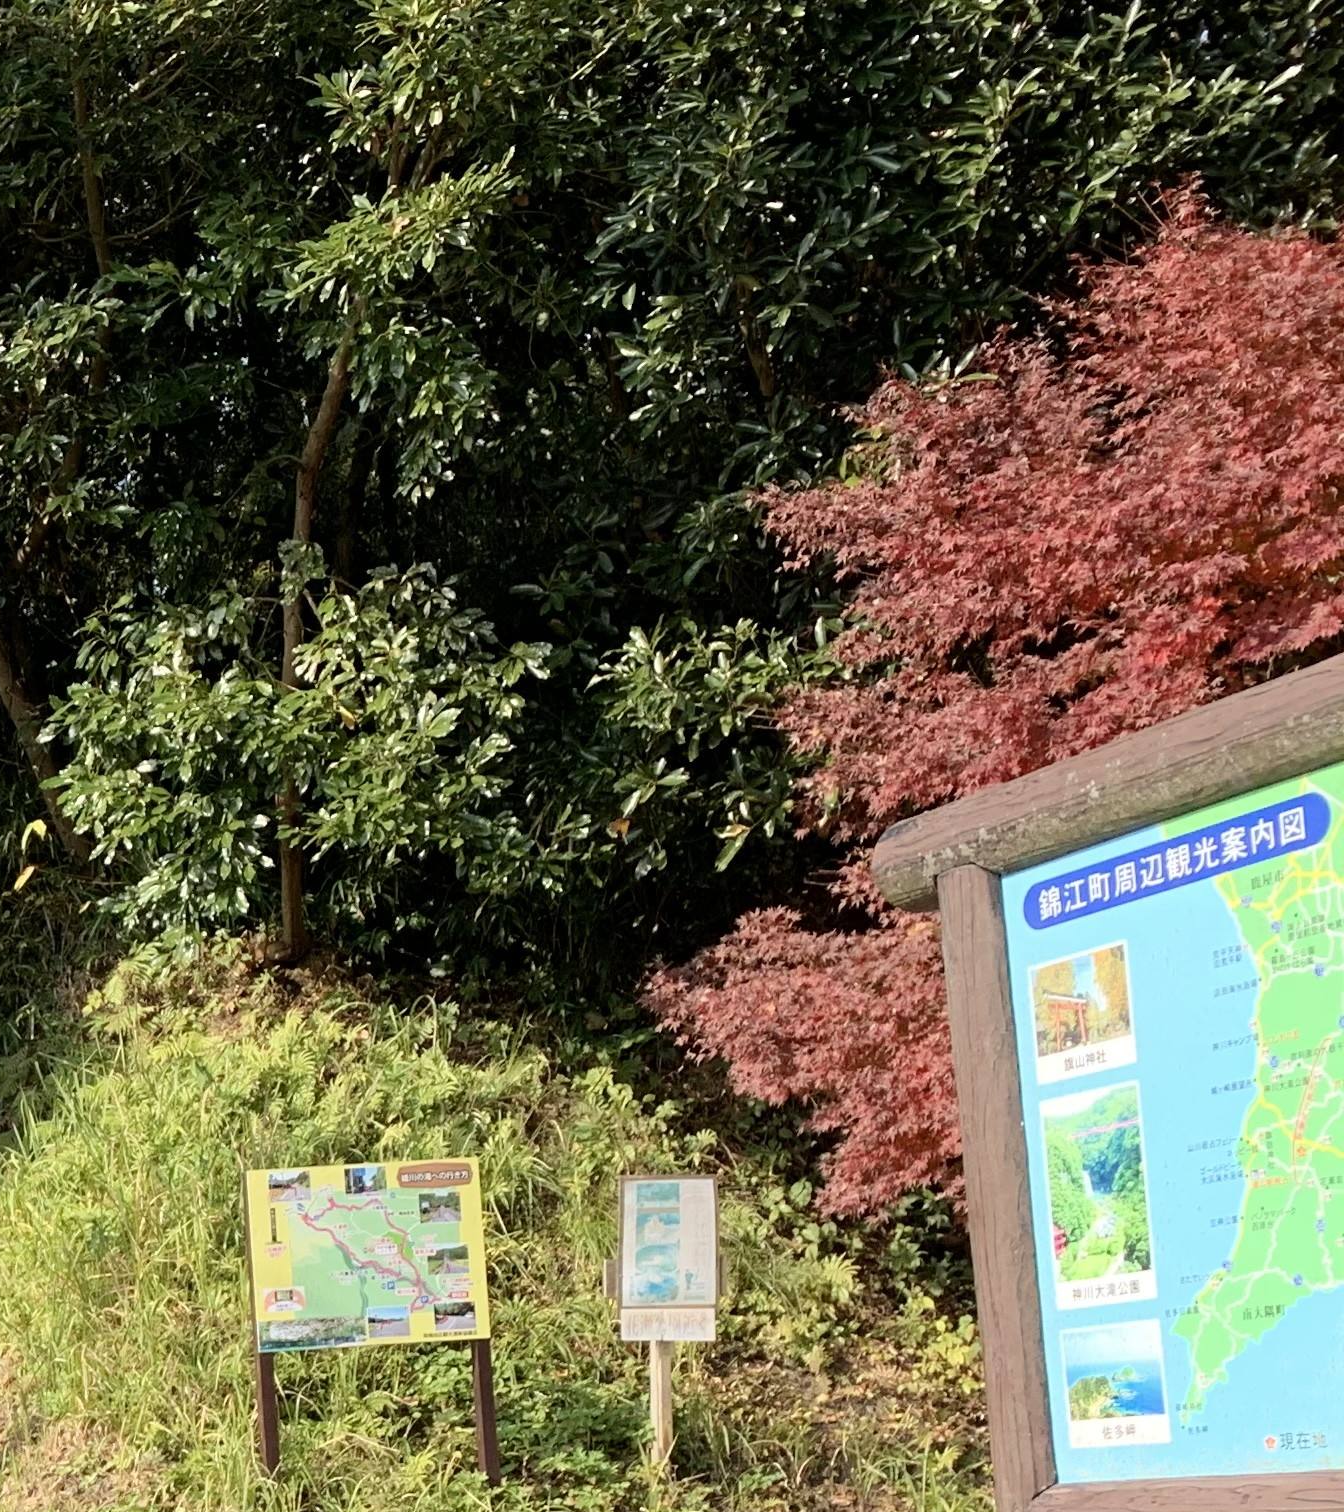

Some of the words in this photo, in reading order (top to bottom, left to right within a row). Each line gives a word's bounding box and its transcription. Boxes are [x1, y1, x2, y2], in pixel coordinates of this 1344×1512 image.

[1037, 805, 1307, 922] 錦江町周辺観光案内図
[1278, 1431, 1329, 1451] 現在地
